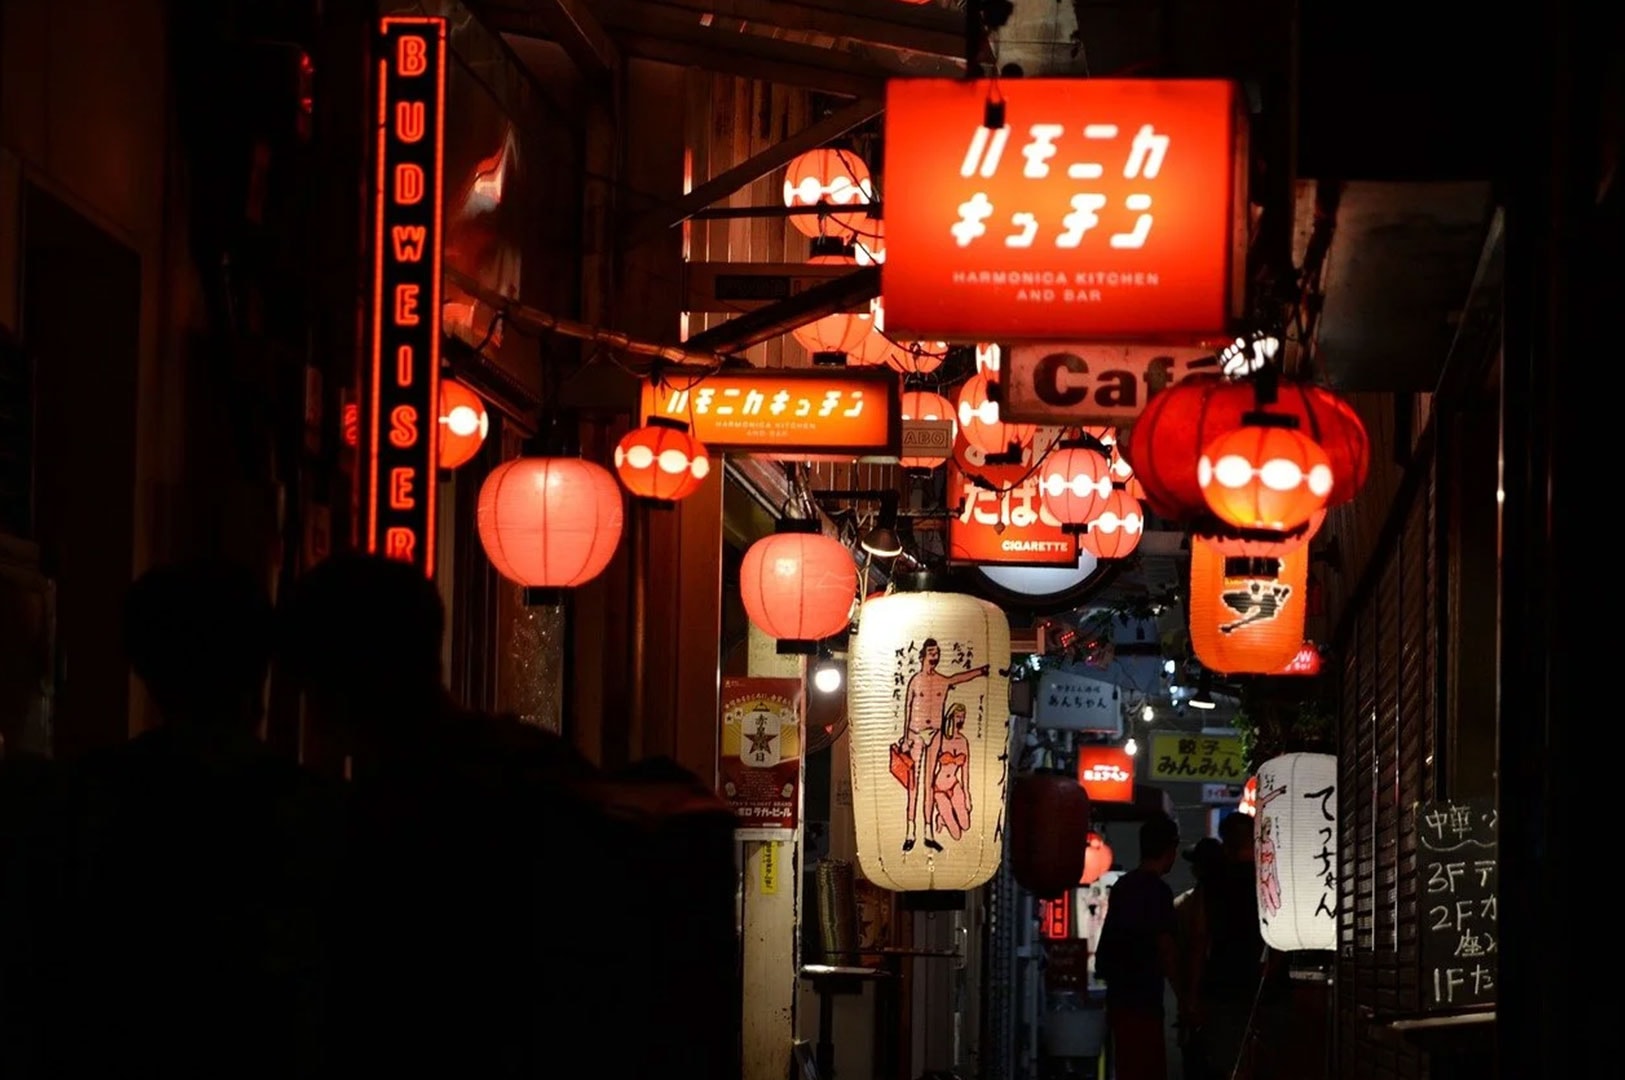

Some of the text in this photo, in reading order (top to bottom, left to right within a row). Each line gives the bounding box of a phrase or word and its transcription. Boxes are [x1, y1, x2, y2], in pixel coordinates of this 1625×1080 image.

[960, 124, 1170, 179] ハモニカ
[951, 192, 1153, 248] キッチン
[953, 271, 1159, 286] HARMONICA KITCHEN
[388, 35, 427, 563] BUDWEISER
[1016, 289, 1102, 302] AND BAR
[715, 421, 816, 430] HARMONICA KITCHEN
[1002, 540, 1069, 552] CIGARETTE
[1158, 756, 1239, 777] みんみん
[1303, 785, 1338, 919] てっちゃん
[1427, 861, 1466, 893] 3F
[1429, 900, 1473, 932] 2F
[1433, 967, 1465, 1003] 1F
